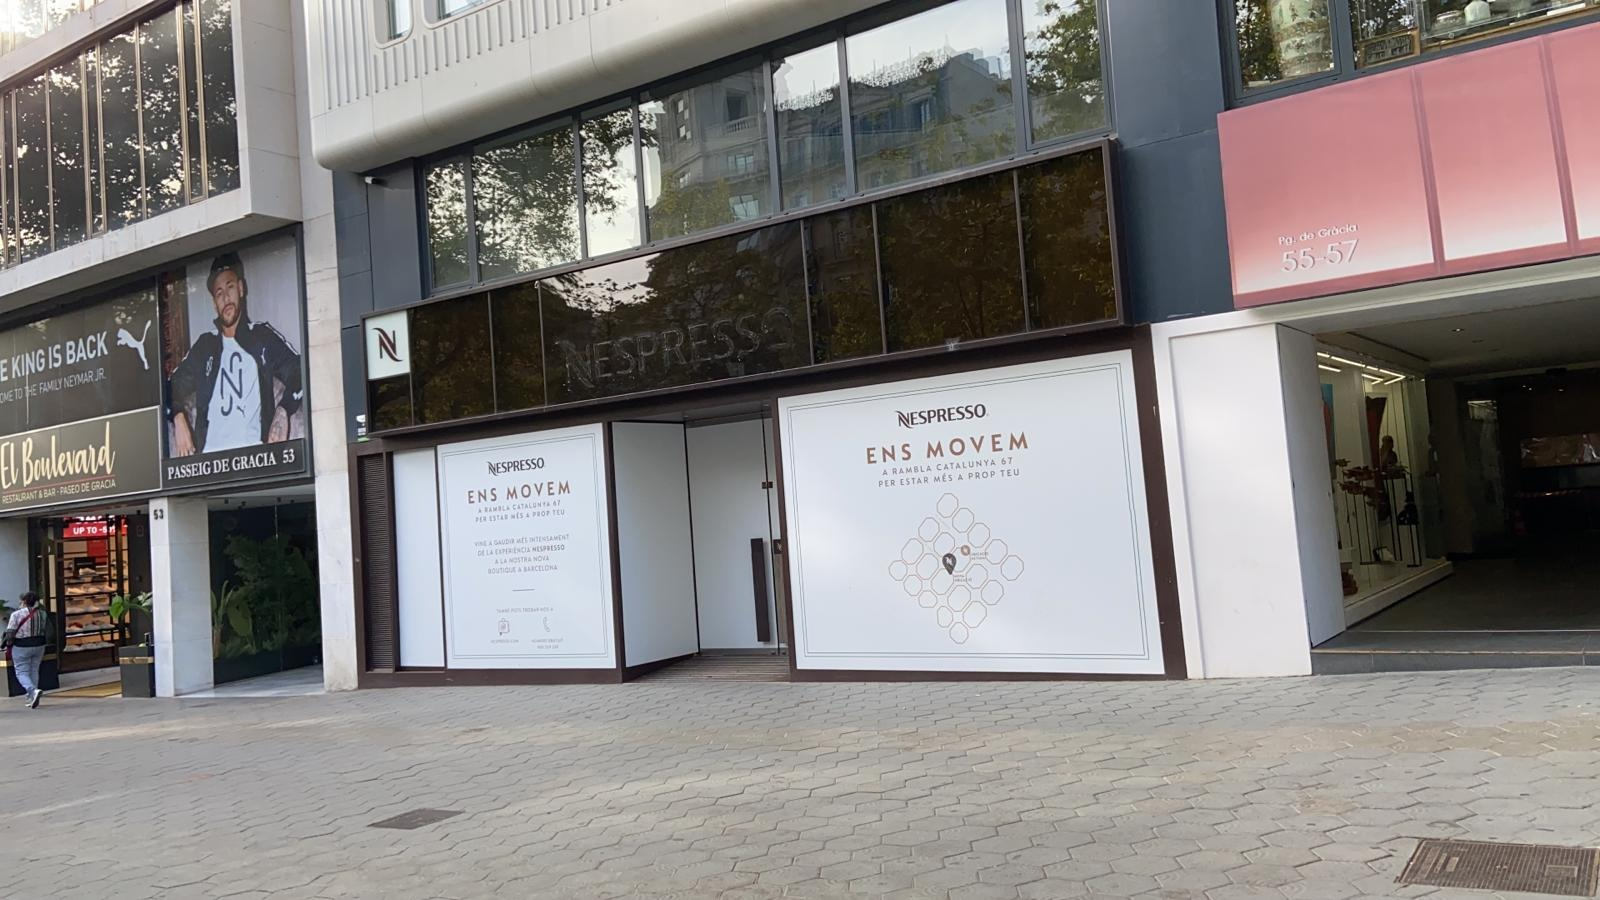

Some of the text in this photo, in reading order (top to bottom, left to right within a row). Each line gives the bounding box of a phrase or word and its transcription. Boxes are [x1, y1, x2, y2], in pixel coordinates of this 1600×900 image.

[1299, 232, 1316, 241] de
[1280, 238, 1359, 273] 55-57
[12, 349, 45, 379] KING
[48, 344, 62, 369] IS
[66, 331, 108, 365] BACK
[15, 387, 23, 400] TO
[24, 383, 37, 397] THE
[39, 377, 63, 394] FAMILY
[64, 370, 94, 389] NEYMAR
[895, 403, 987, 429] NESPRESSO
[0, 421, 116, 489] El Boulevard
[866, 431, 1029, 465] ENS MOVEM
[167, 448, 295, 480] PASSEIG DE GRACIA 53
[487, 457, 545, 476] NESPRESSO
[892, 465, 932, 475] RAMBLA
[936, 458, 996, 471] CATALUNYA
[1001, 456, 1013, 465] 67
[878, 479, 896, 488] PER
[900, 475, 929, 486] ESTAR
[933, 472, 953, 483] MÉS
[968, 470, 996, 480] PROP
[1000, 468, 1020, 477] TEU
[2, 491, 37, 504] RESTAURANT
[43, 487, 56, 498] BAR
[60, 482, 80, 495] PASEO
[81, 482, 91, 492] DE
[91, 478, 116, 490] GRACIA
[467, 479, 571, 504] ENS MOVEM
[153, 508, 164, 520] 53
[484, 505, 510, 513] RAMBLA
[512, 501, 550, 510] CATALUNYA
[552, 499, 561, 507] 67
[489, 513, 509, 522] ESTAR
[510, 511, 524, 520] MÉS
[532, 509, 550, 518] PROP
[552, 508, 565, 516] TEU
[73, 527, 85, 535] UP
[87, 526, 98, 534] TO
[486, 548, 494, 556] LA
[532, 544, 565, 553] NESPRESSO
[523, 564, 558, 573] BARCELONA
